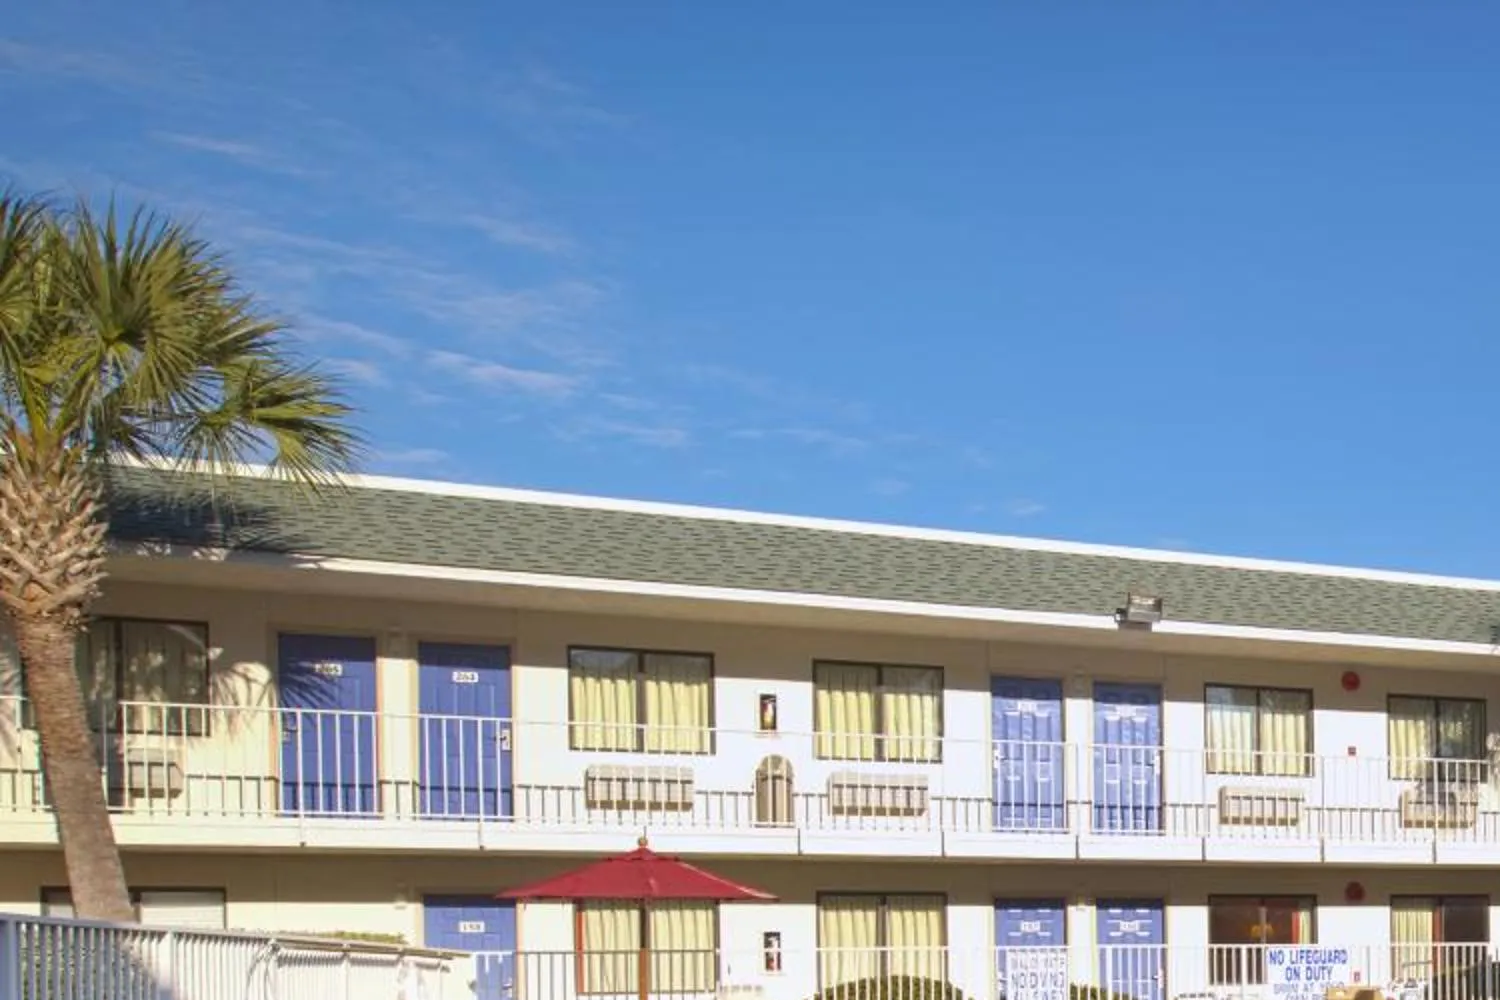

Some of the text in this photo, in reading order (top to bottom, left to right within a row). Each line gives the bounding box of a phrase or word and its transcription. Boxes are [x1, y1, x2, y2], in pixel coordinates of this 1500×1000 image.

[1269, 948, 1348, 965] NO LIFEGUARD
[1285, 966, 1333, 981] ON DUTY
